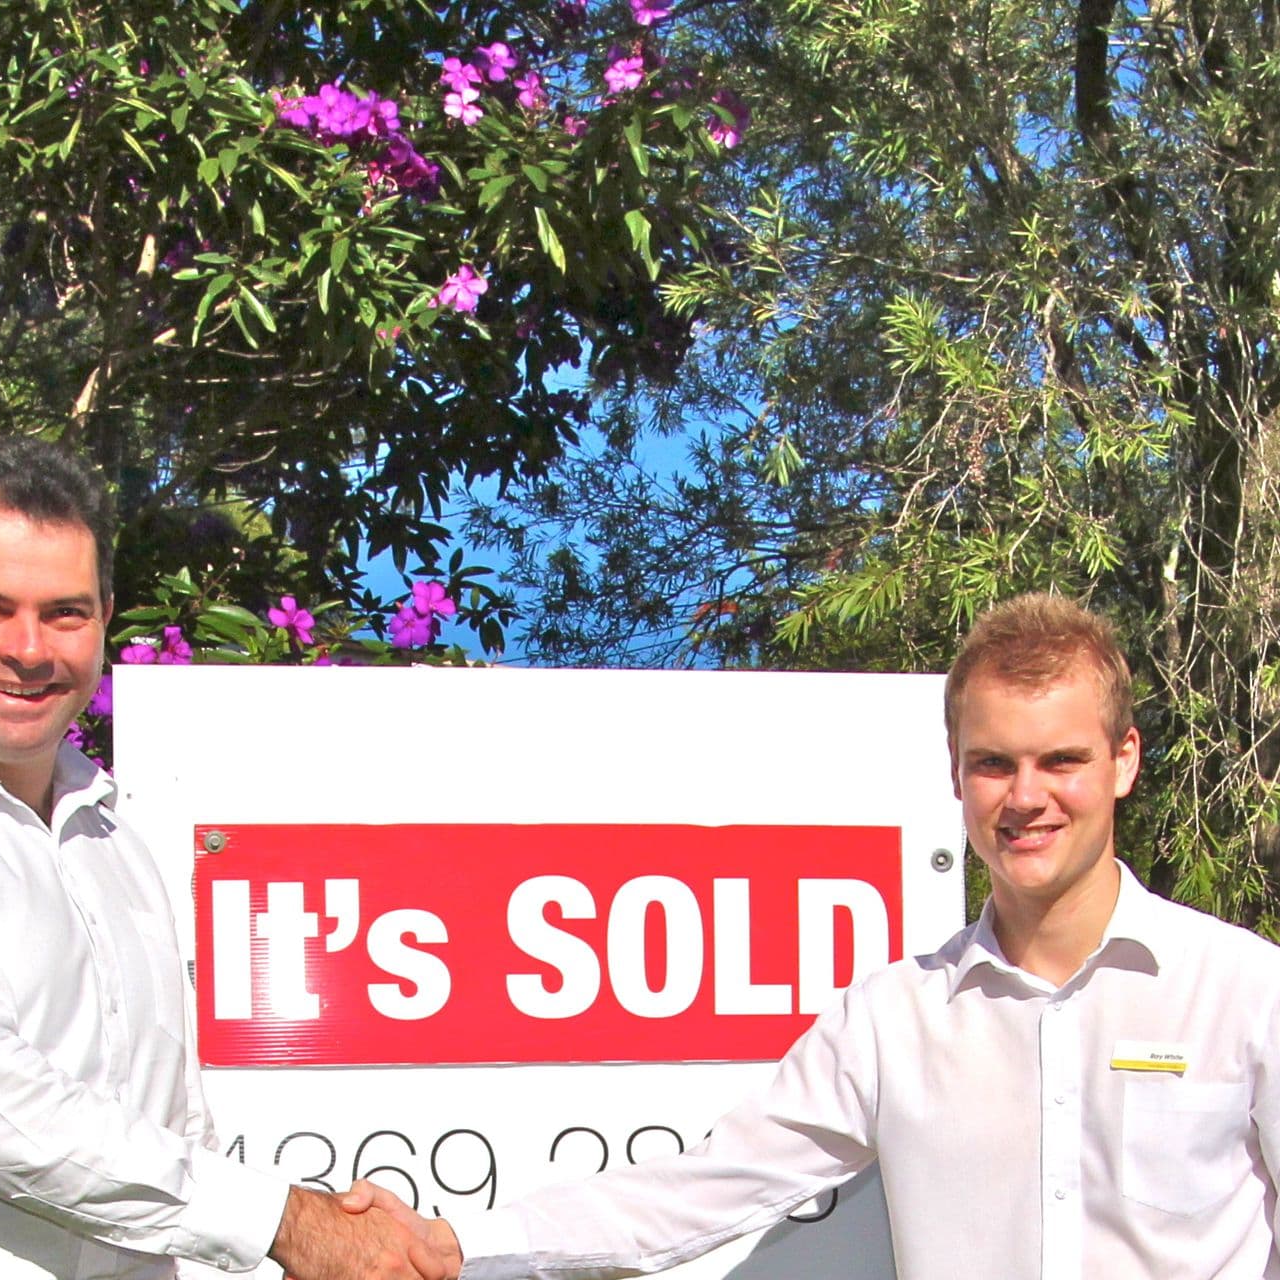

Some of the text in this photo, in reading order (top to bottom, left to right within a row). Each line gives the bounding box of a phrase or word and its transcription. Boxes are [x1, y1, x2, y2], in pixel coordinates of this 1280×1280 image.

[211, 876, 890, 1021] It's SOLD
[225, 1128, 497, 1218] 369
